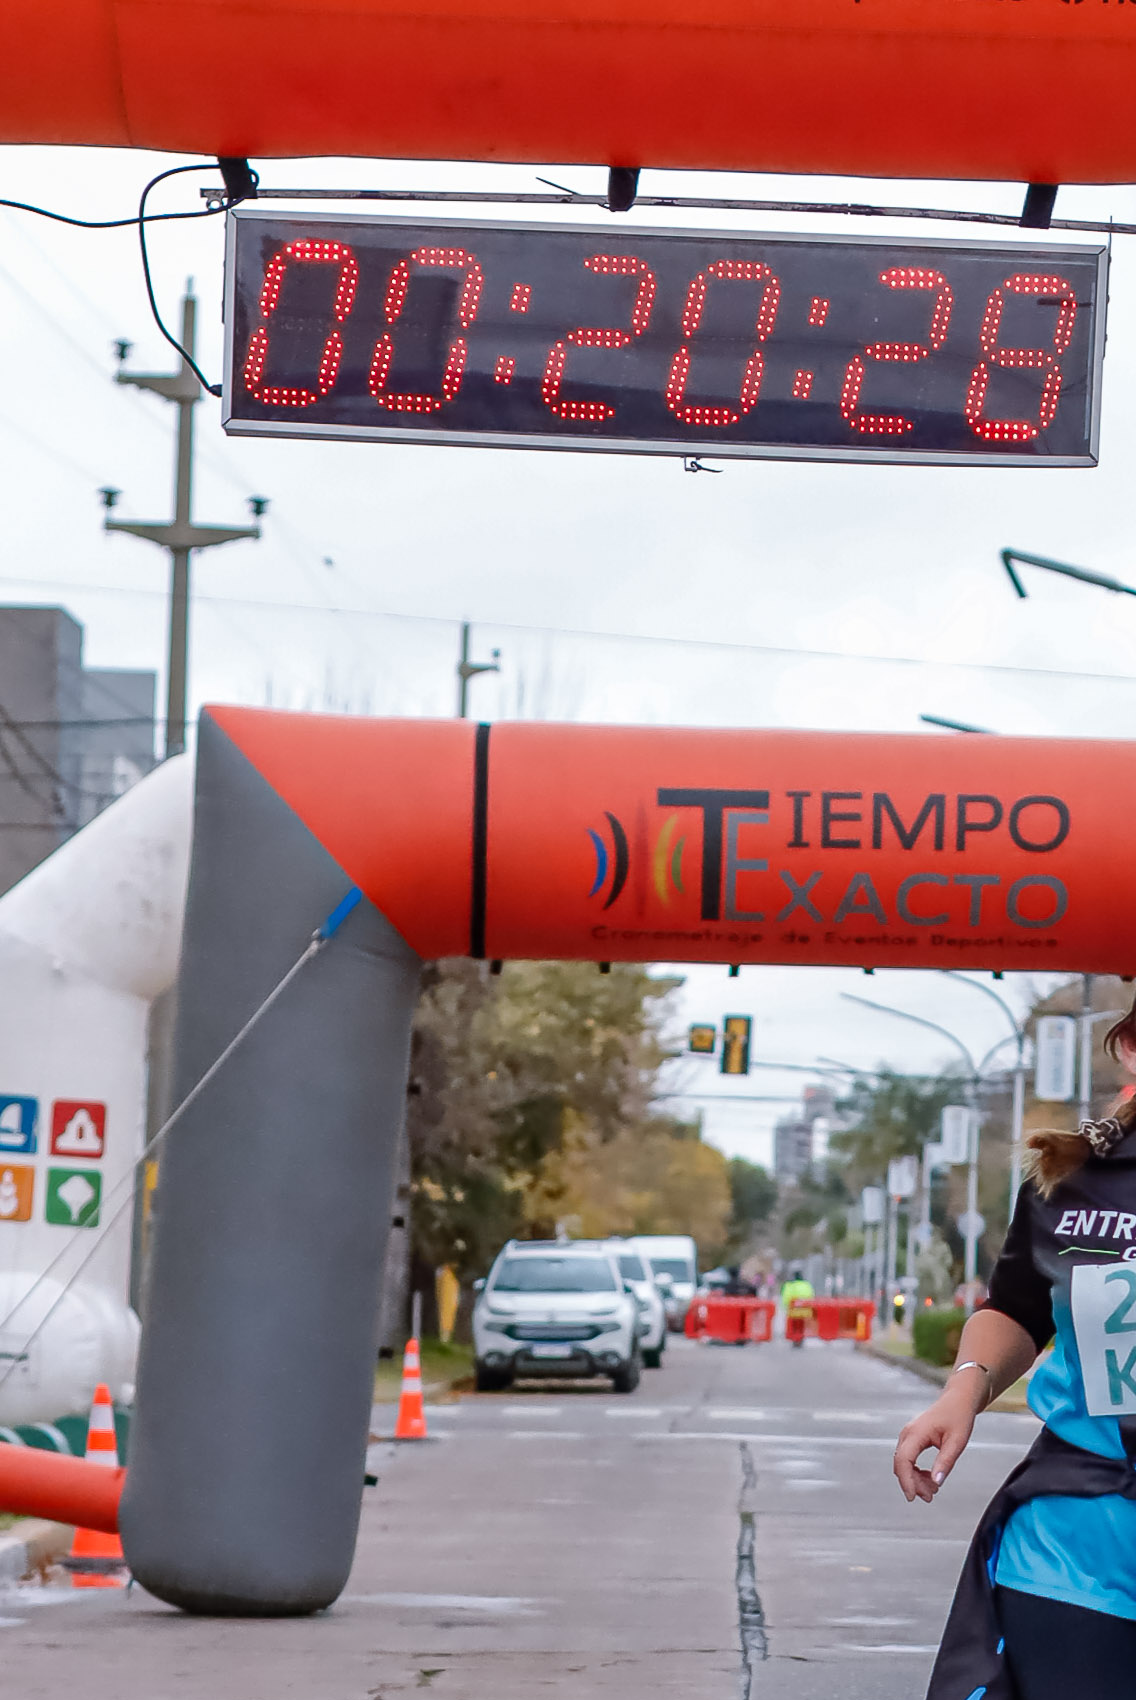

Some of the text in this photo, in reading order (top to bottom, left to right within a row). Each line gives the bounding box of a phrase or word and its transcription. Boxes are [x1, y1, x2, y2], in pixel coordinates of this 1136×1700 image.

[245, 239, 1077, 441] 00:20:28
[657, 788, 1071, 921] TIEMPO
[724, 812, 1069, 929] EXACTO
